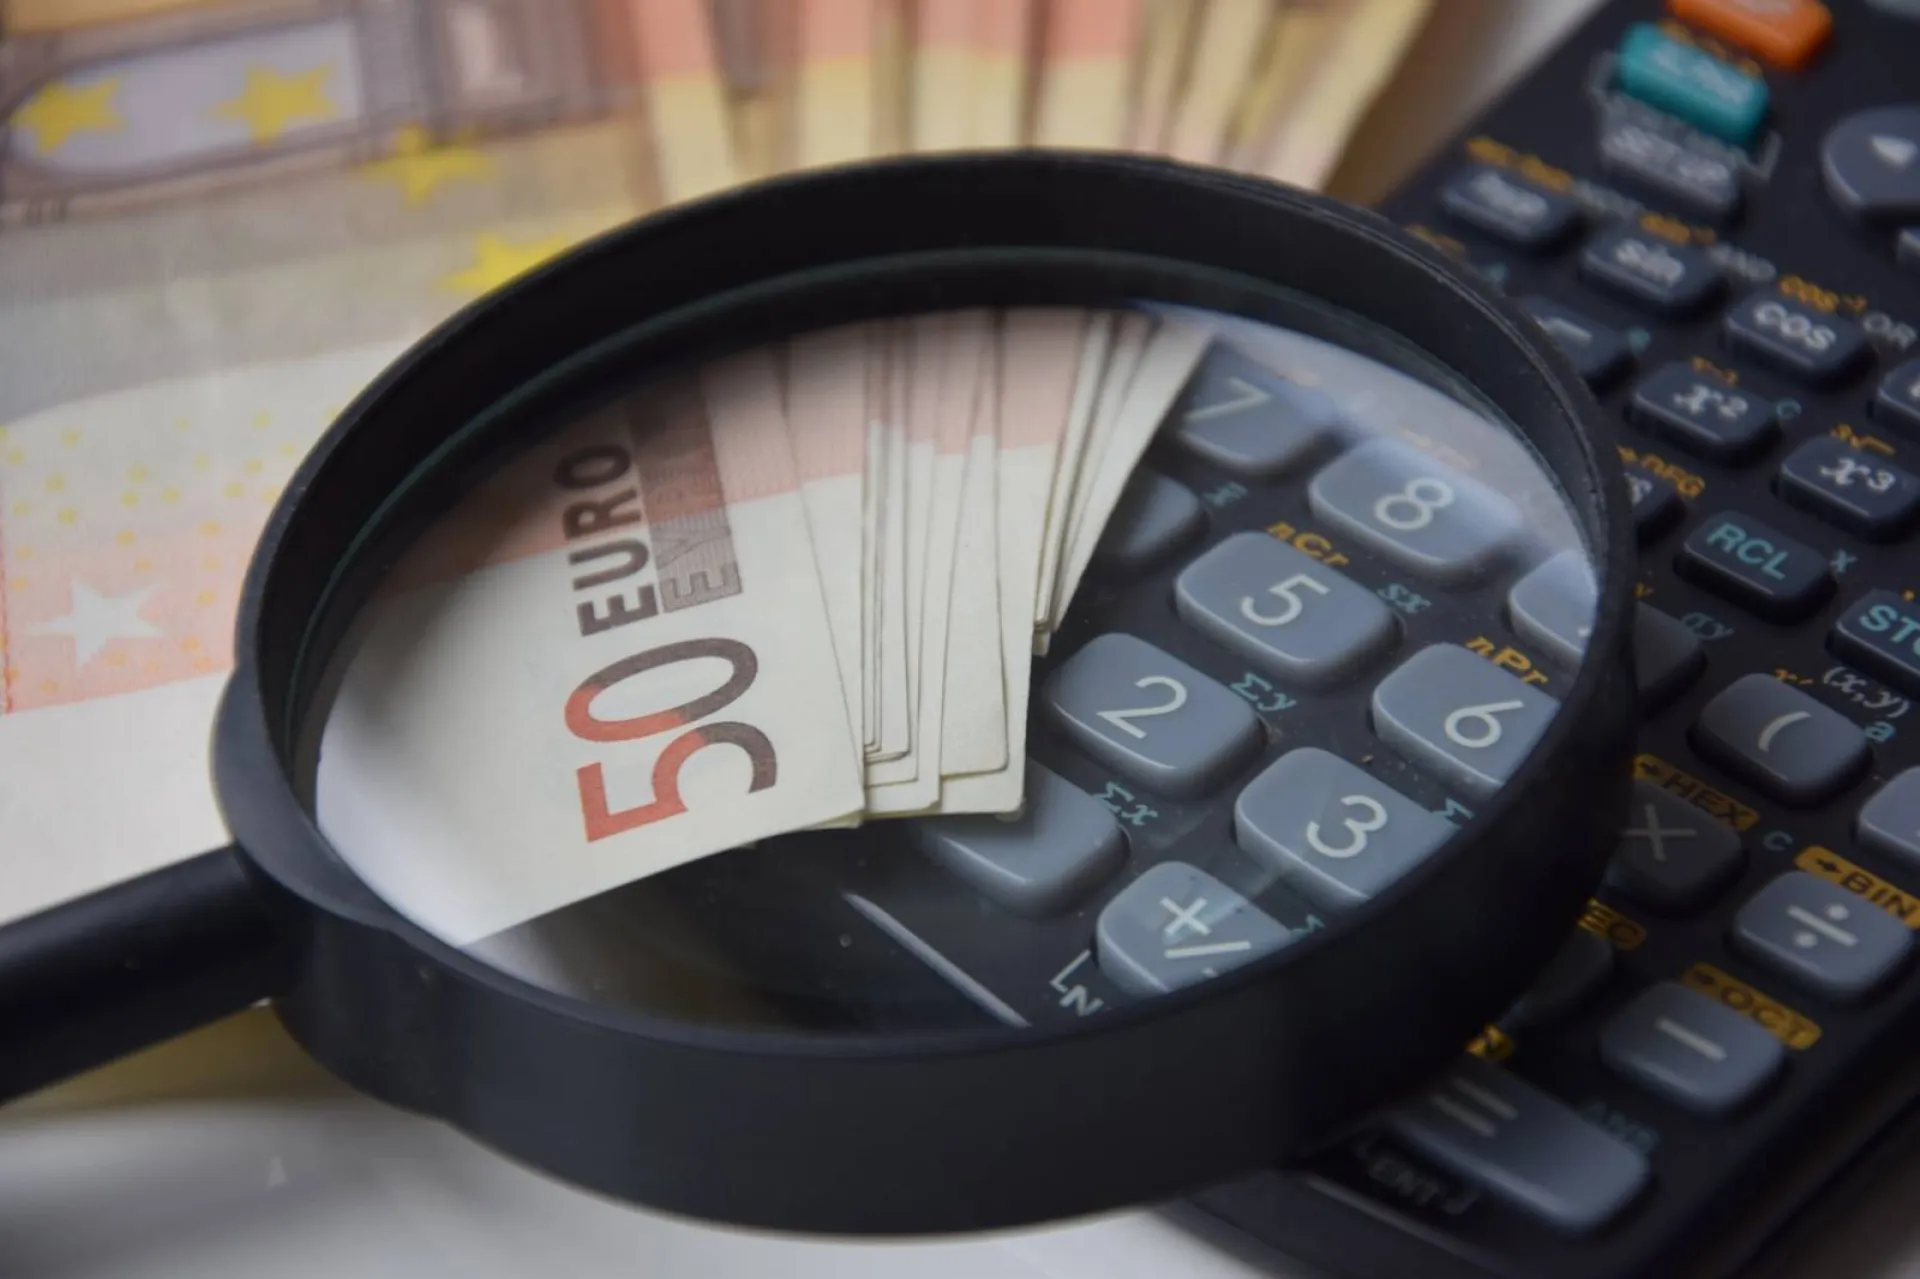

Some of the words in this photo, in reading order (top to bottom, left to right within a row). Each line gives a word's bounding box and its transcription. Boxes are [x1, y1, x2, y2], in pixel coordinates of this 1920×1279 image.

[1183, 376, 1273, 421] 7
[1372, 477, 1455, 532] 8
[553, 443, 660, 638] EURO
[1265, 520, 1350, 567] nCr
[1705, 522, 1790, 581] RCL
[1240, 573, 1331, 627] 5
[1858, 603, 1920, 664] ST
[1465, 635, 1551, 688] nPr
[1095, 675, 1188, 740] 2
[1443, 698, 1525, 749] 6
[564, 637, 778, 843] 50
[1305, 794, 1388, 859] 3
[1661, 772, 1750, 828] HEX
[1839, 871, 1919, 919] BIN
